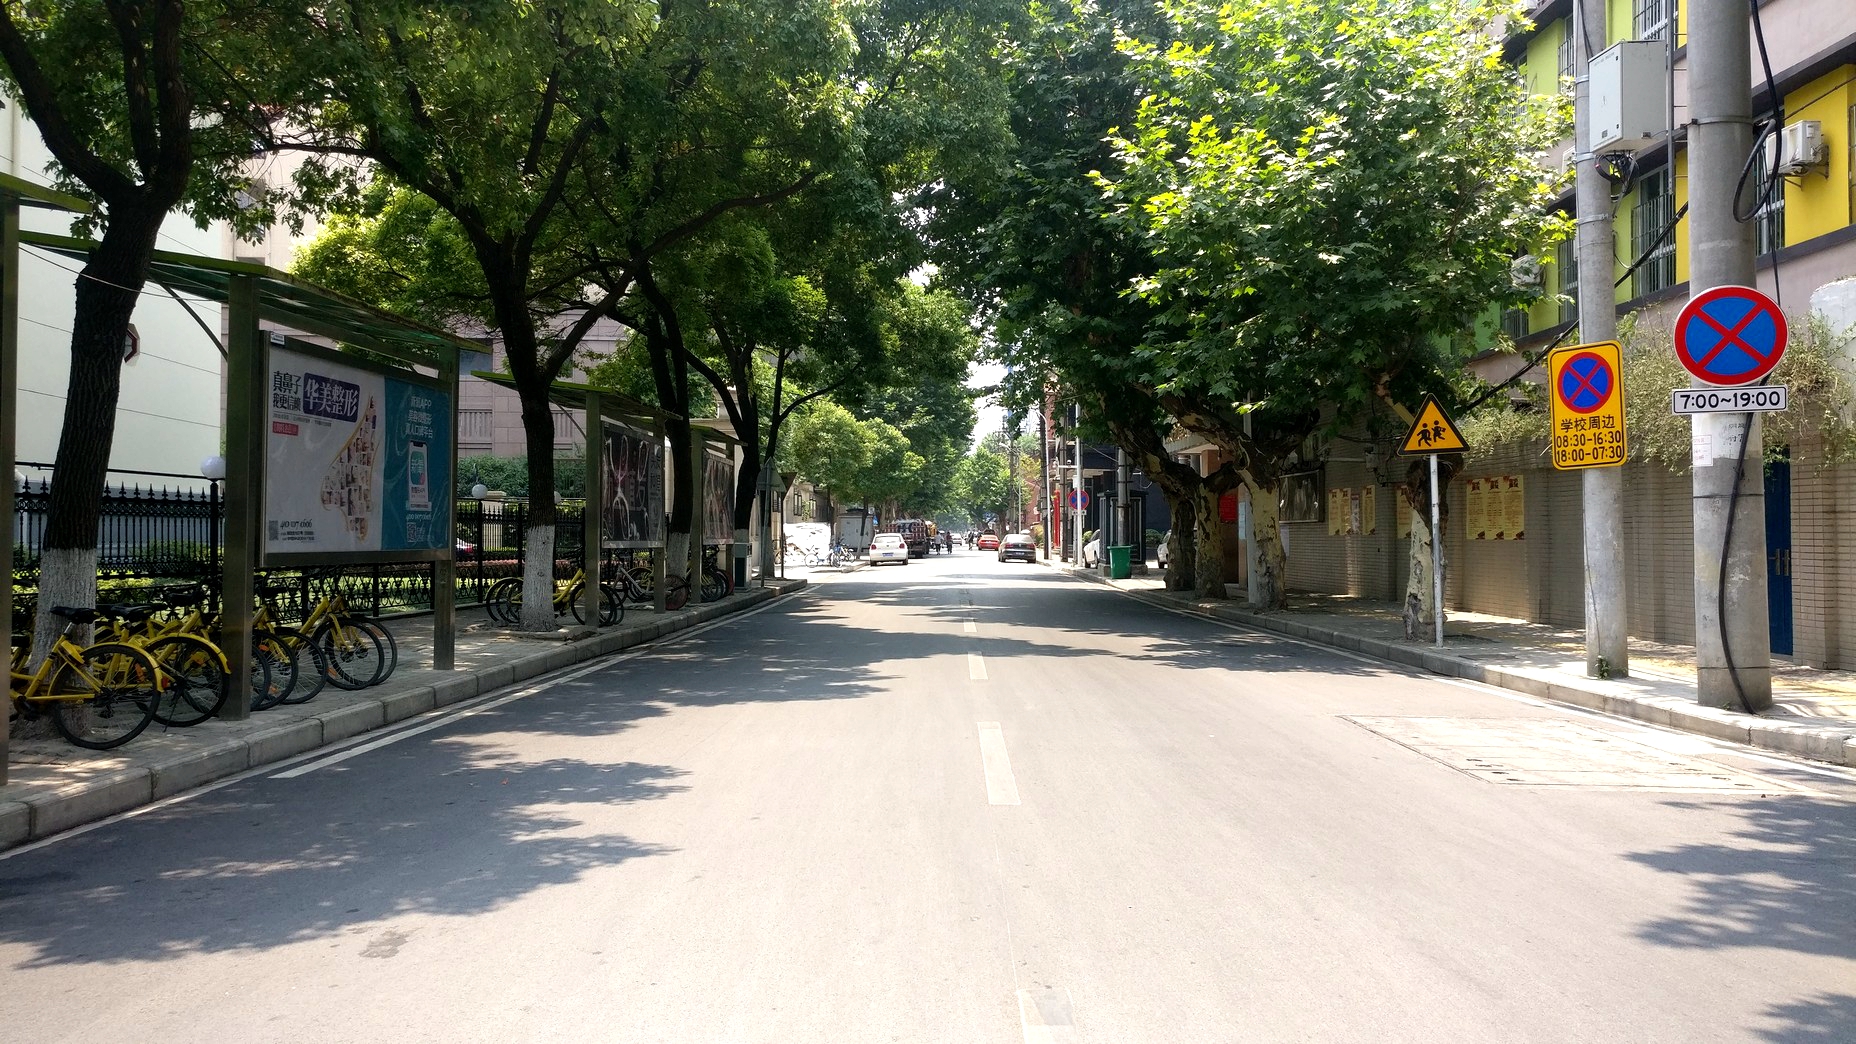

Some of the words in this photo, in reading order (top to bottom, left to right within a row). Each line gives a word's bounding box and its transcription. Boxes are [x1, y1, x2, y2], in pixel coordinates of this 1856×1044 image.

[304, 377, 359, 417] 华美整形
[1680, 391, 1780, 409] 7:00~19:00
[1560, 414, 1616, 433] 学校周边
[1556, 430, 1622, 449] 08:30-16:30
[1557, 445, 1622, 464] 18:00-07:30
